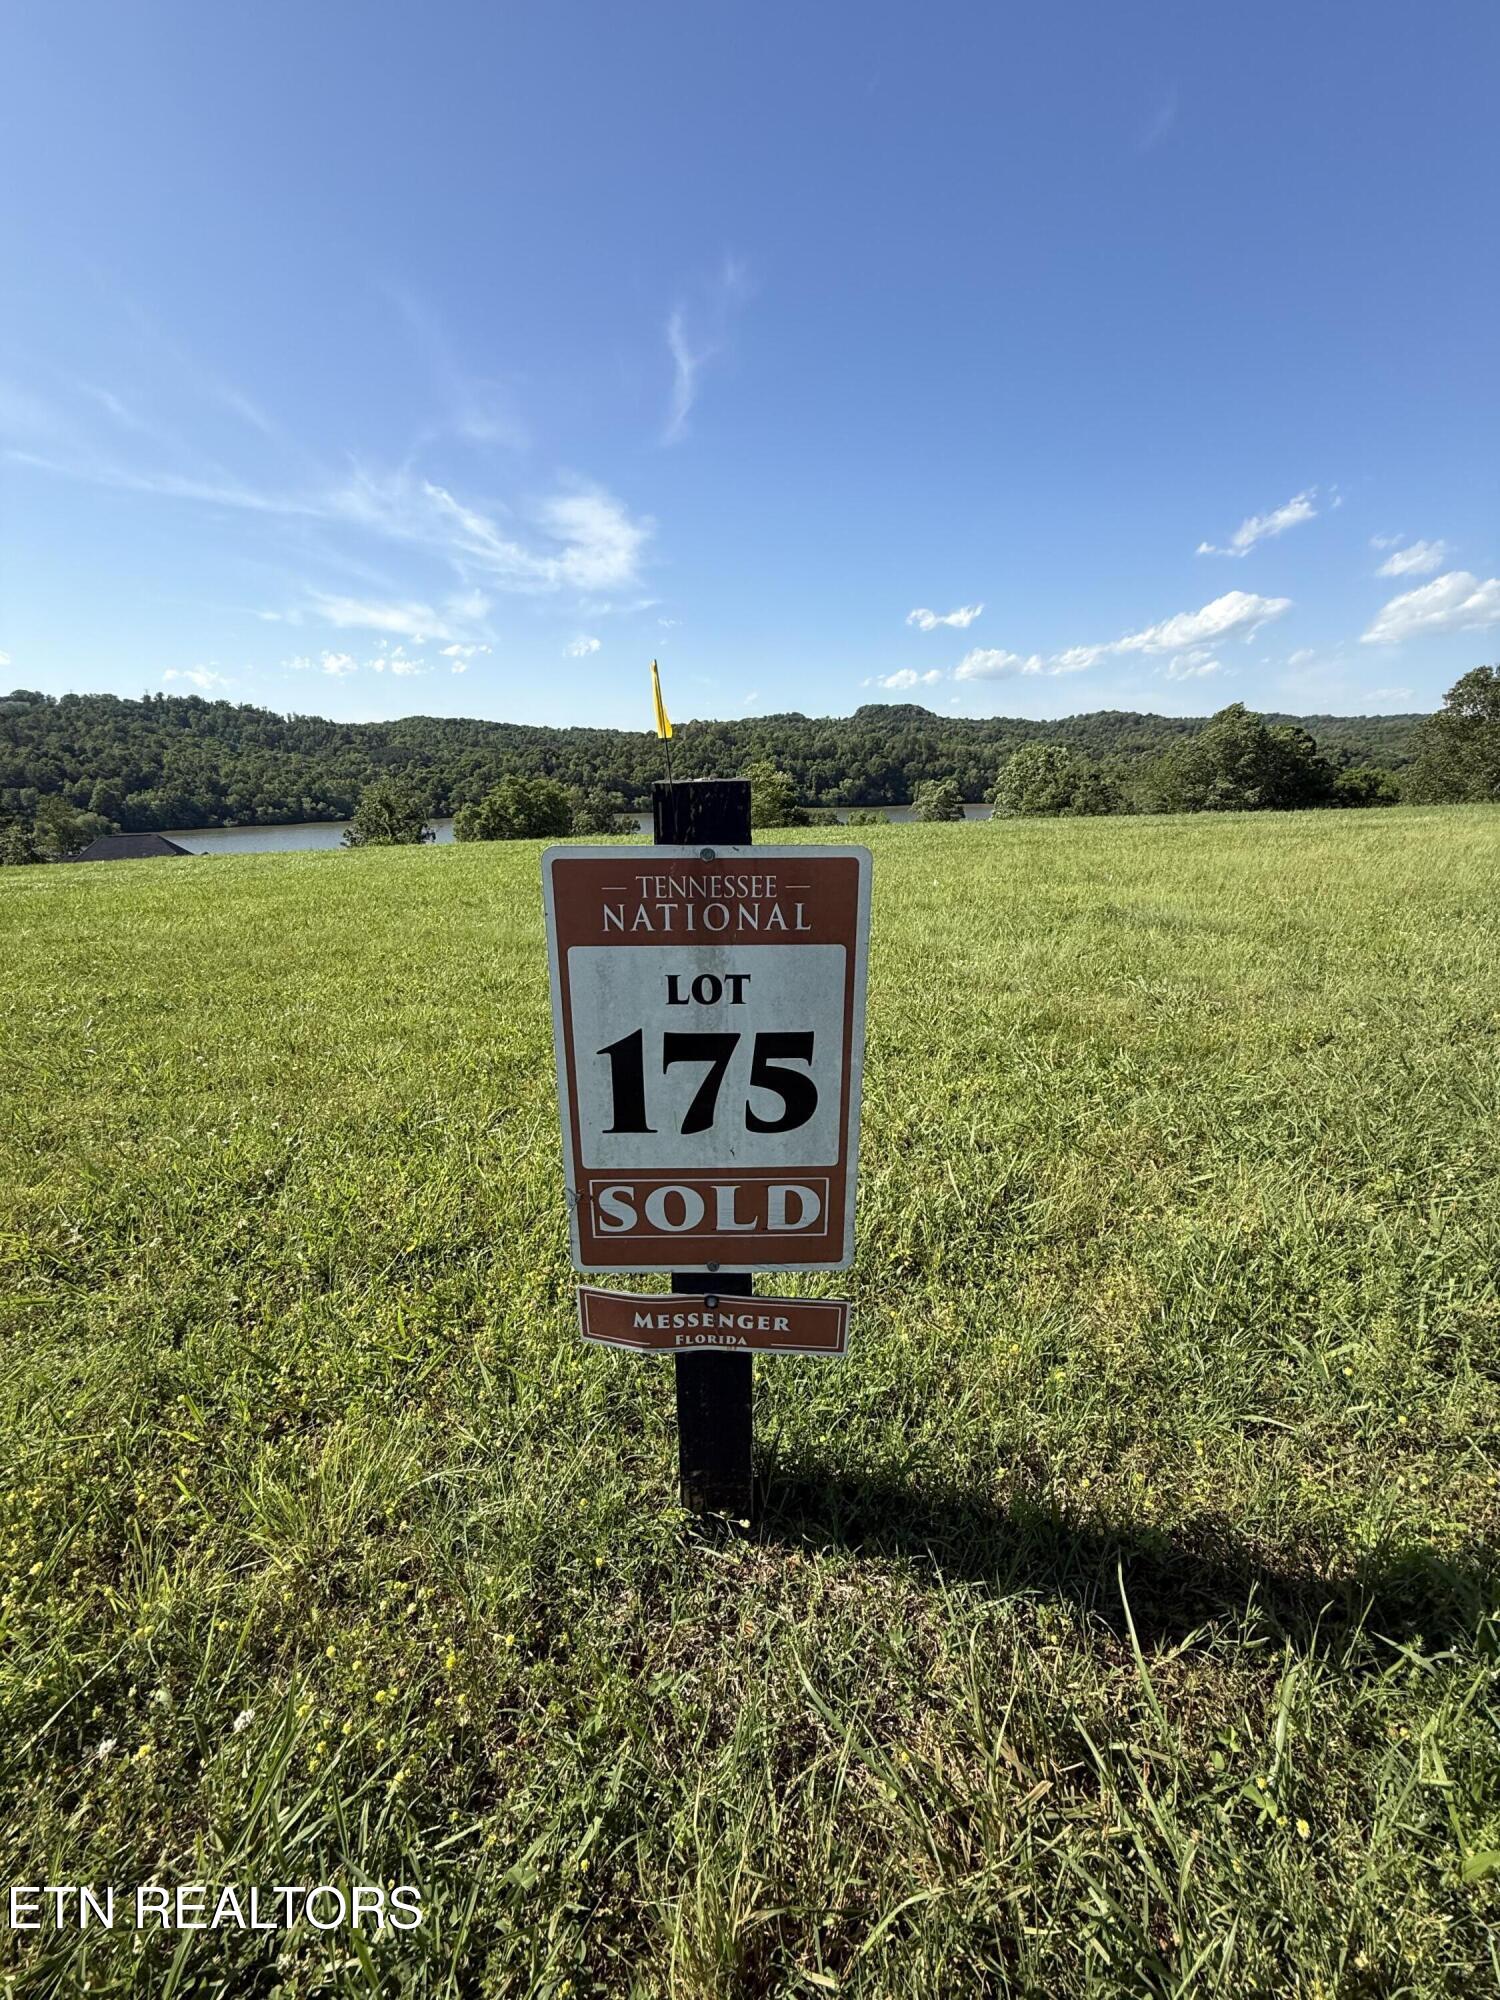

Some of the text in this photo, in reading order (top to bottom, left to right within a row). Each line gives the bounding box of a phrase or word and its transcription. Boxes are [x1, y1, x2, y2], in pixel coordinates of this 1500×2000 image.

[635, 875, 778, 899] TENNESSEE
[602, 903, 812, 932] NATIONAL
[665, 973, 751, 1005] LOT
[596, 1028, 819, 1135] 175
[598, 1184, 821, 1232] SOLD
[633, 1311, 791, 1332] MESSENGER
[675, 1334, 747, 1346] FLORIDA
